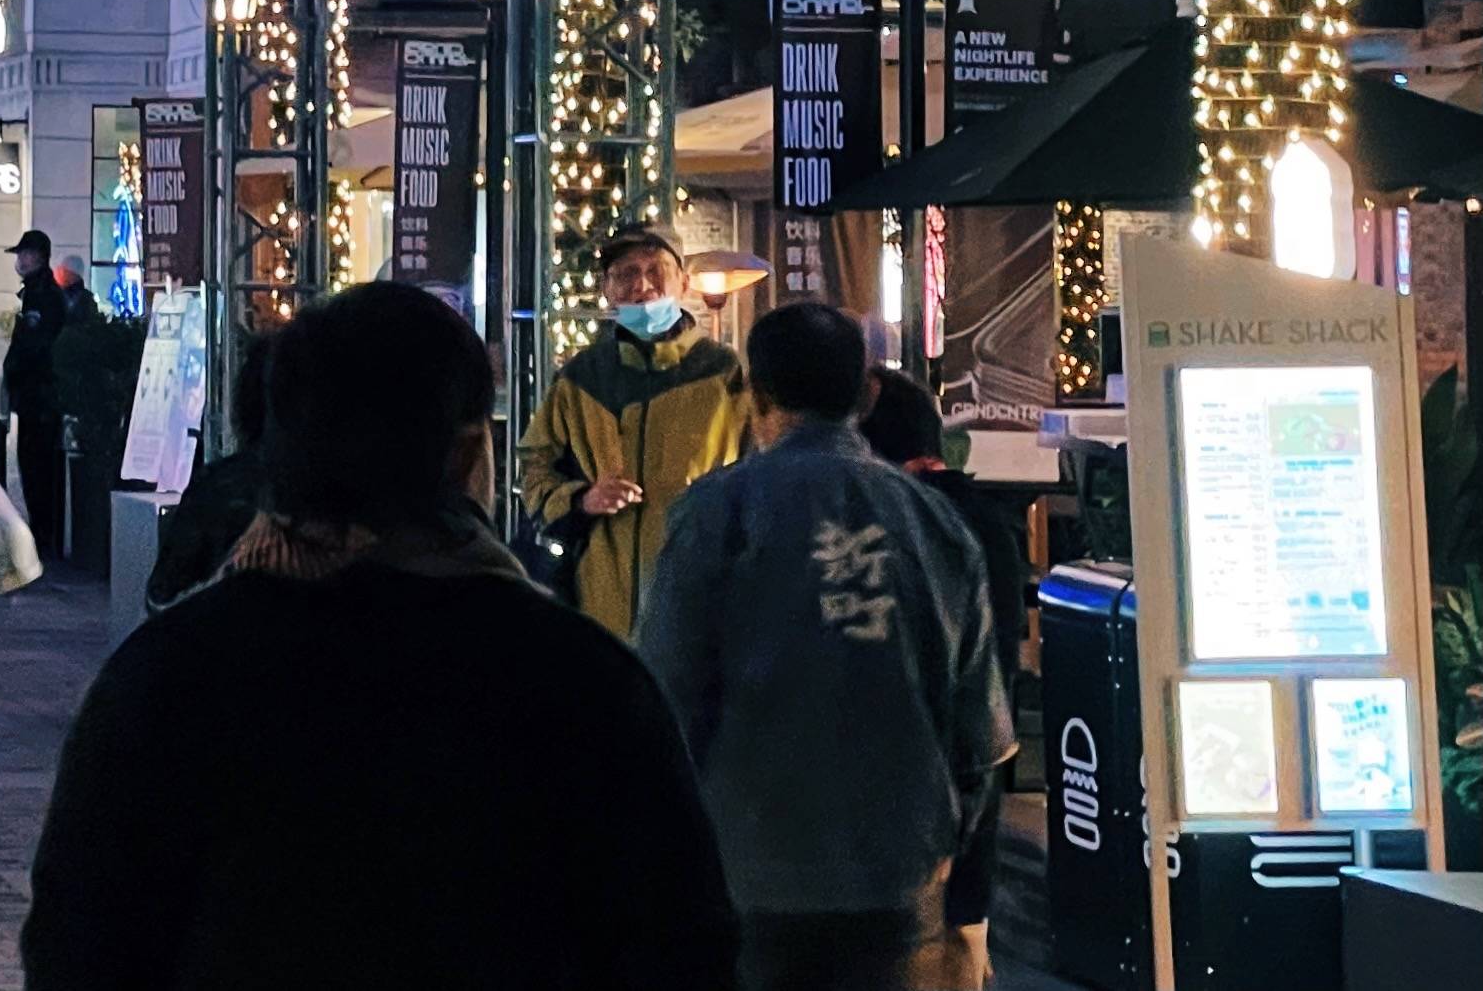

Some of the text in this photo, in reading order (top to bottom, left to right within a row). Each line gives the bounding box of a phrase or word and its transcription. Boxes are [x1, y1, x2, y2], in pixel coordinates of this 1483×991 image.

[954, 31, 1006, 46] A NEW
[782, 42, 839, 93] DRINK
[954, 49, 1035, 66] NIGHTLIFE
[953, 67, 1049, 84] EXPERIENCE
[402, 85, 448, 124] DRINK
[783, 100, 844, 150] MUSIC
[146, 137, 182, 169] DRINK
[401, 126, 450, 166] MUSIC
[147, 171, 186, 202] MUSIC
[400, 169, 439, 208] FOOD
[784, 157, 832, 208] FOOD
[148, 204, 178, 235] FOOD
[1178, 316, 1390, 347] SHAKE SHACK
